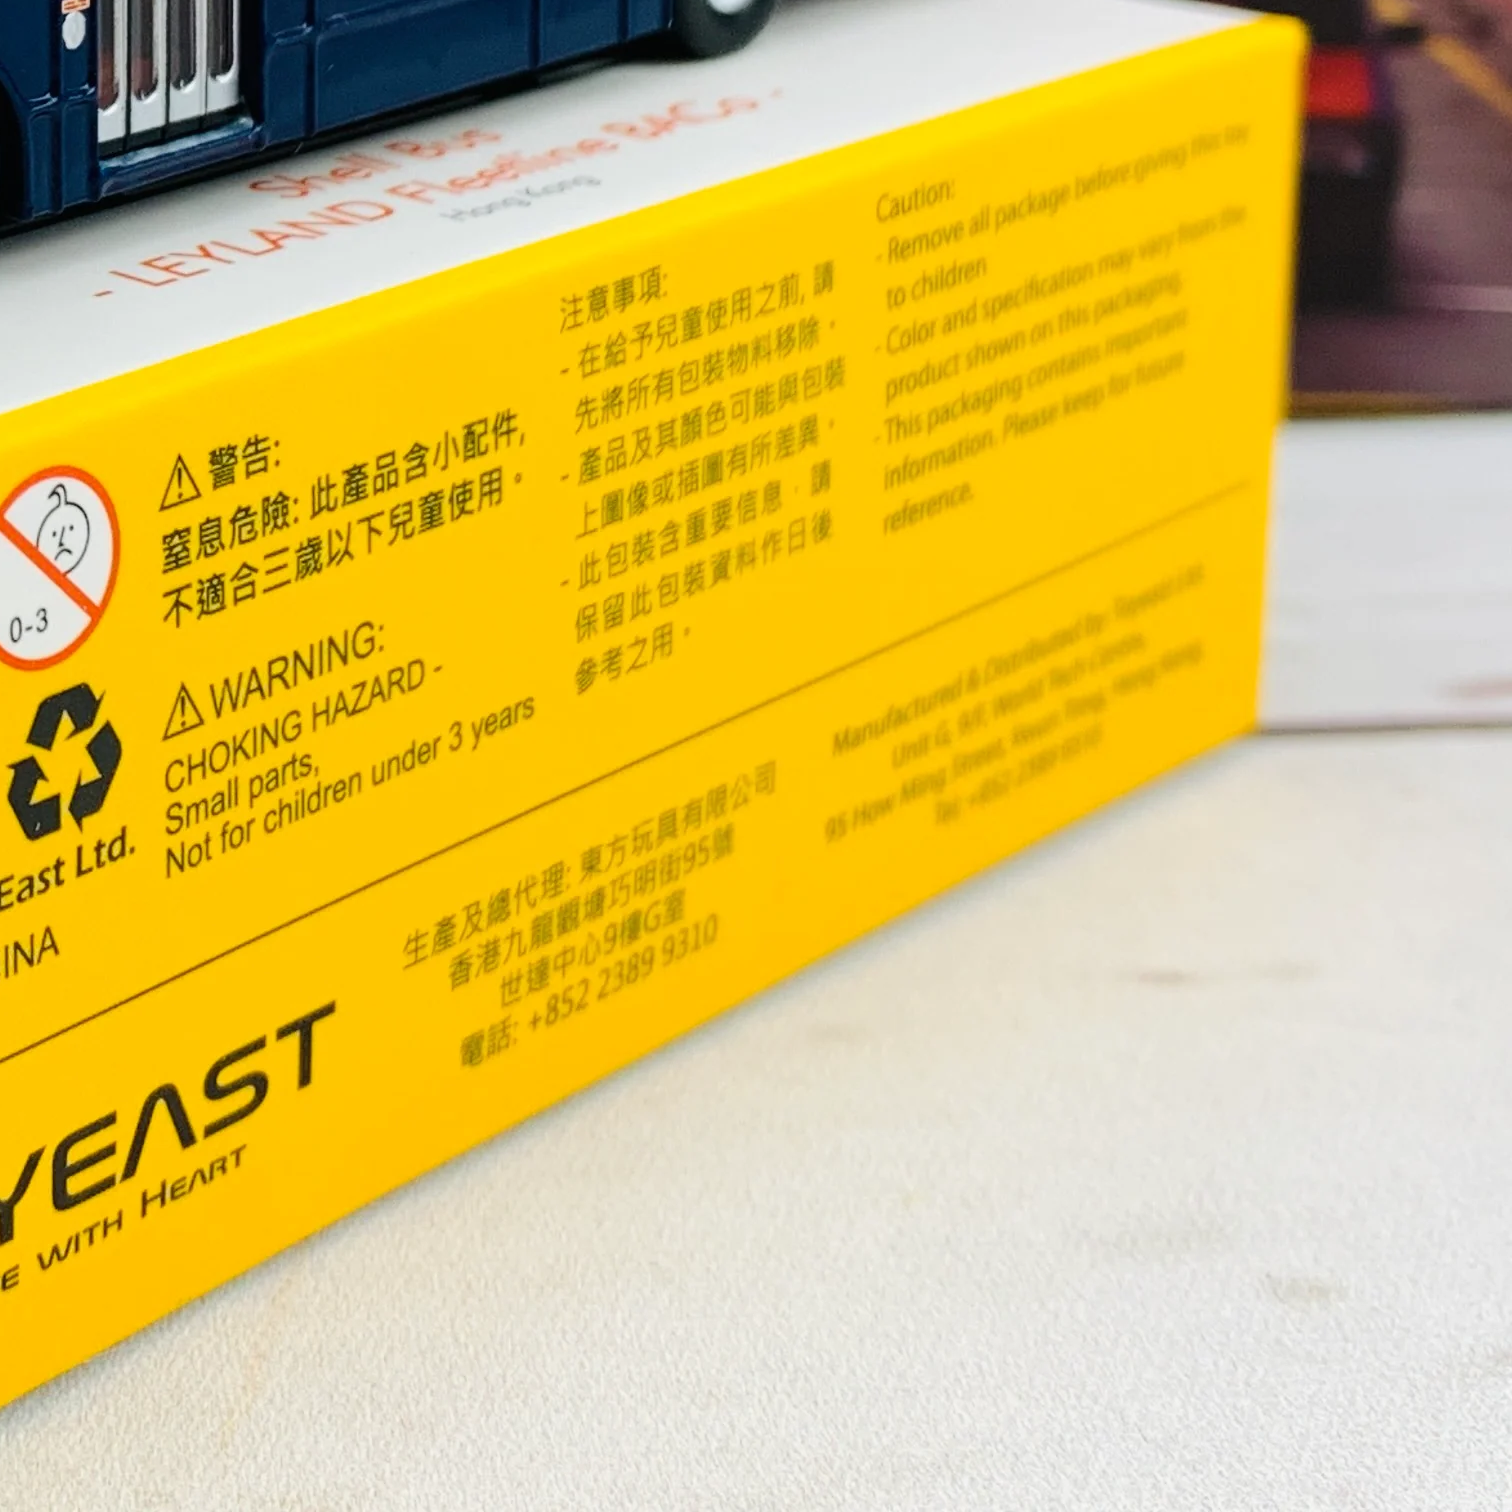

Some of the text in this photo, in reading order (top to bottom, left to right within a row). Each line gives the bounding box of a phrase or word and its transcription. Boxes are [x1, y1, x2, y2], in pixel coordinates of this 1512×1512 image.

[248, 128, 503, 200] Shell Bus
[875, 177, 956, 224] Caution:
[108, 200, 396, 287] LEYLAND
[887, 219, 965, 265] Remove
[968, 202, 992, 239] all
[994, 184, 1072, 235] package
[559, 264, 669, 334] 注意事項:
[886, 256, 988, 312] to children
[886, 319, 938, 356] Color
[941, 296, 978, 336] and
[982, 261, 1094, 325] specification
[884, 410, 922, 445] This
[927, 373, 1024, 435] packaging
[1026, 344, 1102, 390] contains
[885, 352, 962, 407] product
[965, 327, 1027, 371] shown
[1029, 319, 1055, 348] on
[1058, 304, 1089, 336] this
[207, 433, 281, 491] 警告:
[883, 428, 998, 491] information.
[1002, 402, 1059, 446] Please
[8, 606, 49, 643] 0-3
[209, 619, 385, 720] WARNING:
[164, 709, 303, 793] CHOKING
[311, 658, 426, 733] HAZARD
[164, 695, 537, 879] Not for children under 3 years
[165, 751, 321, 837] Small parts,
[75, 824, 136, 880] Ltd.
[528, 978, 589, 1034] +852
[596, 946, 655, 1002] 2389
[661, 912, 720, 968] 9310
